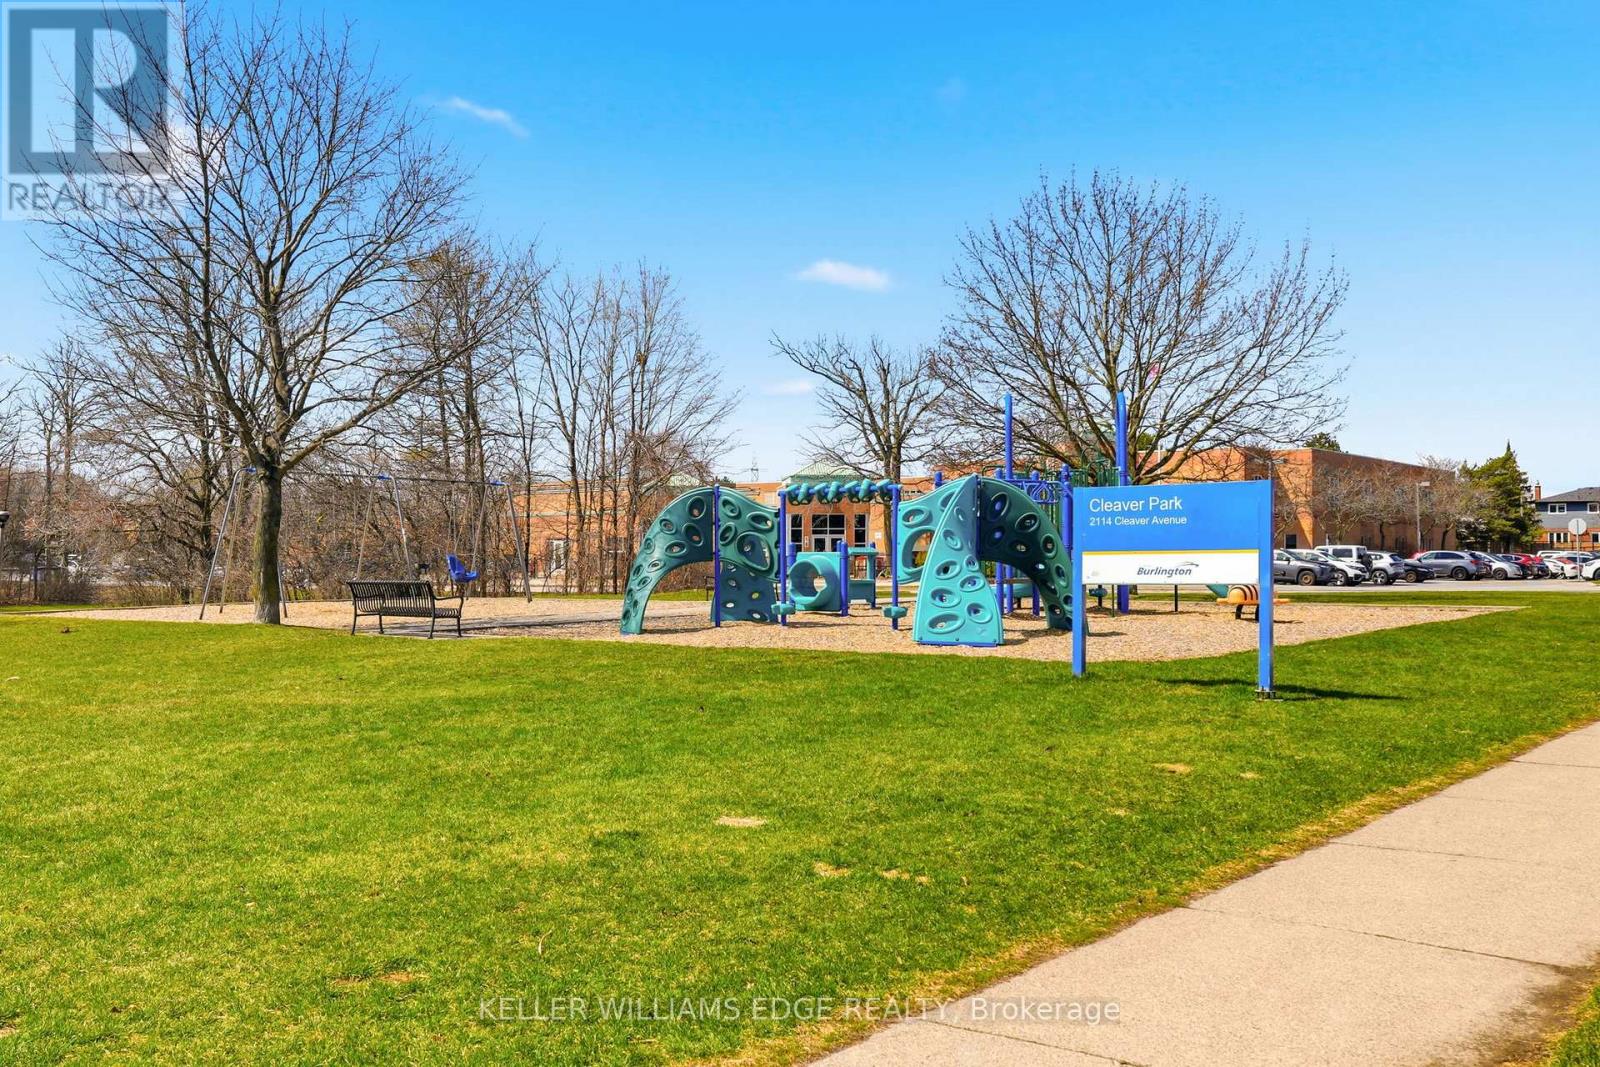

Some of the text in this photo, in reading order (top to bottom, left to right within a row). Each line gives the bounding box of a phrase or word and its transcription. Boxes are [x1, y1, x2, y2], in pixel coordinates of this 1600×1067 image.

[1089, 496, 1183, 513] Cleaver Park
[1089, 515, 1187, 526] 2114 Cleaver Avenue
[1137, 566, 1192, 578] Burlington
